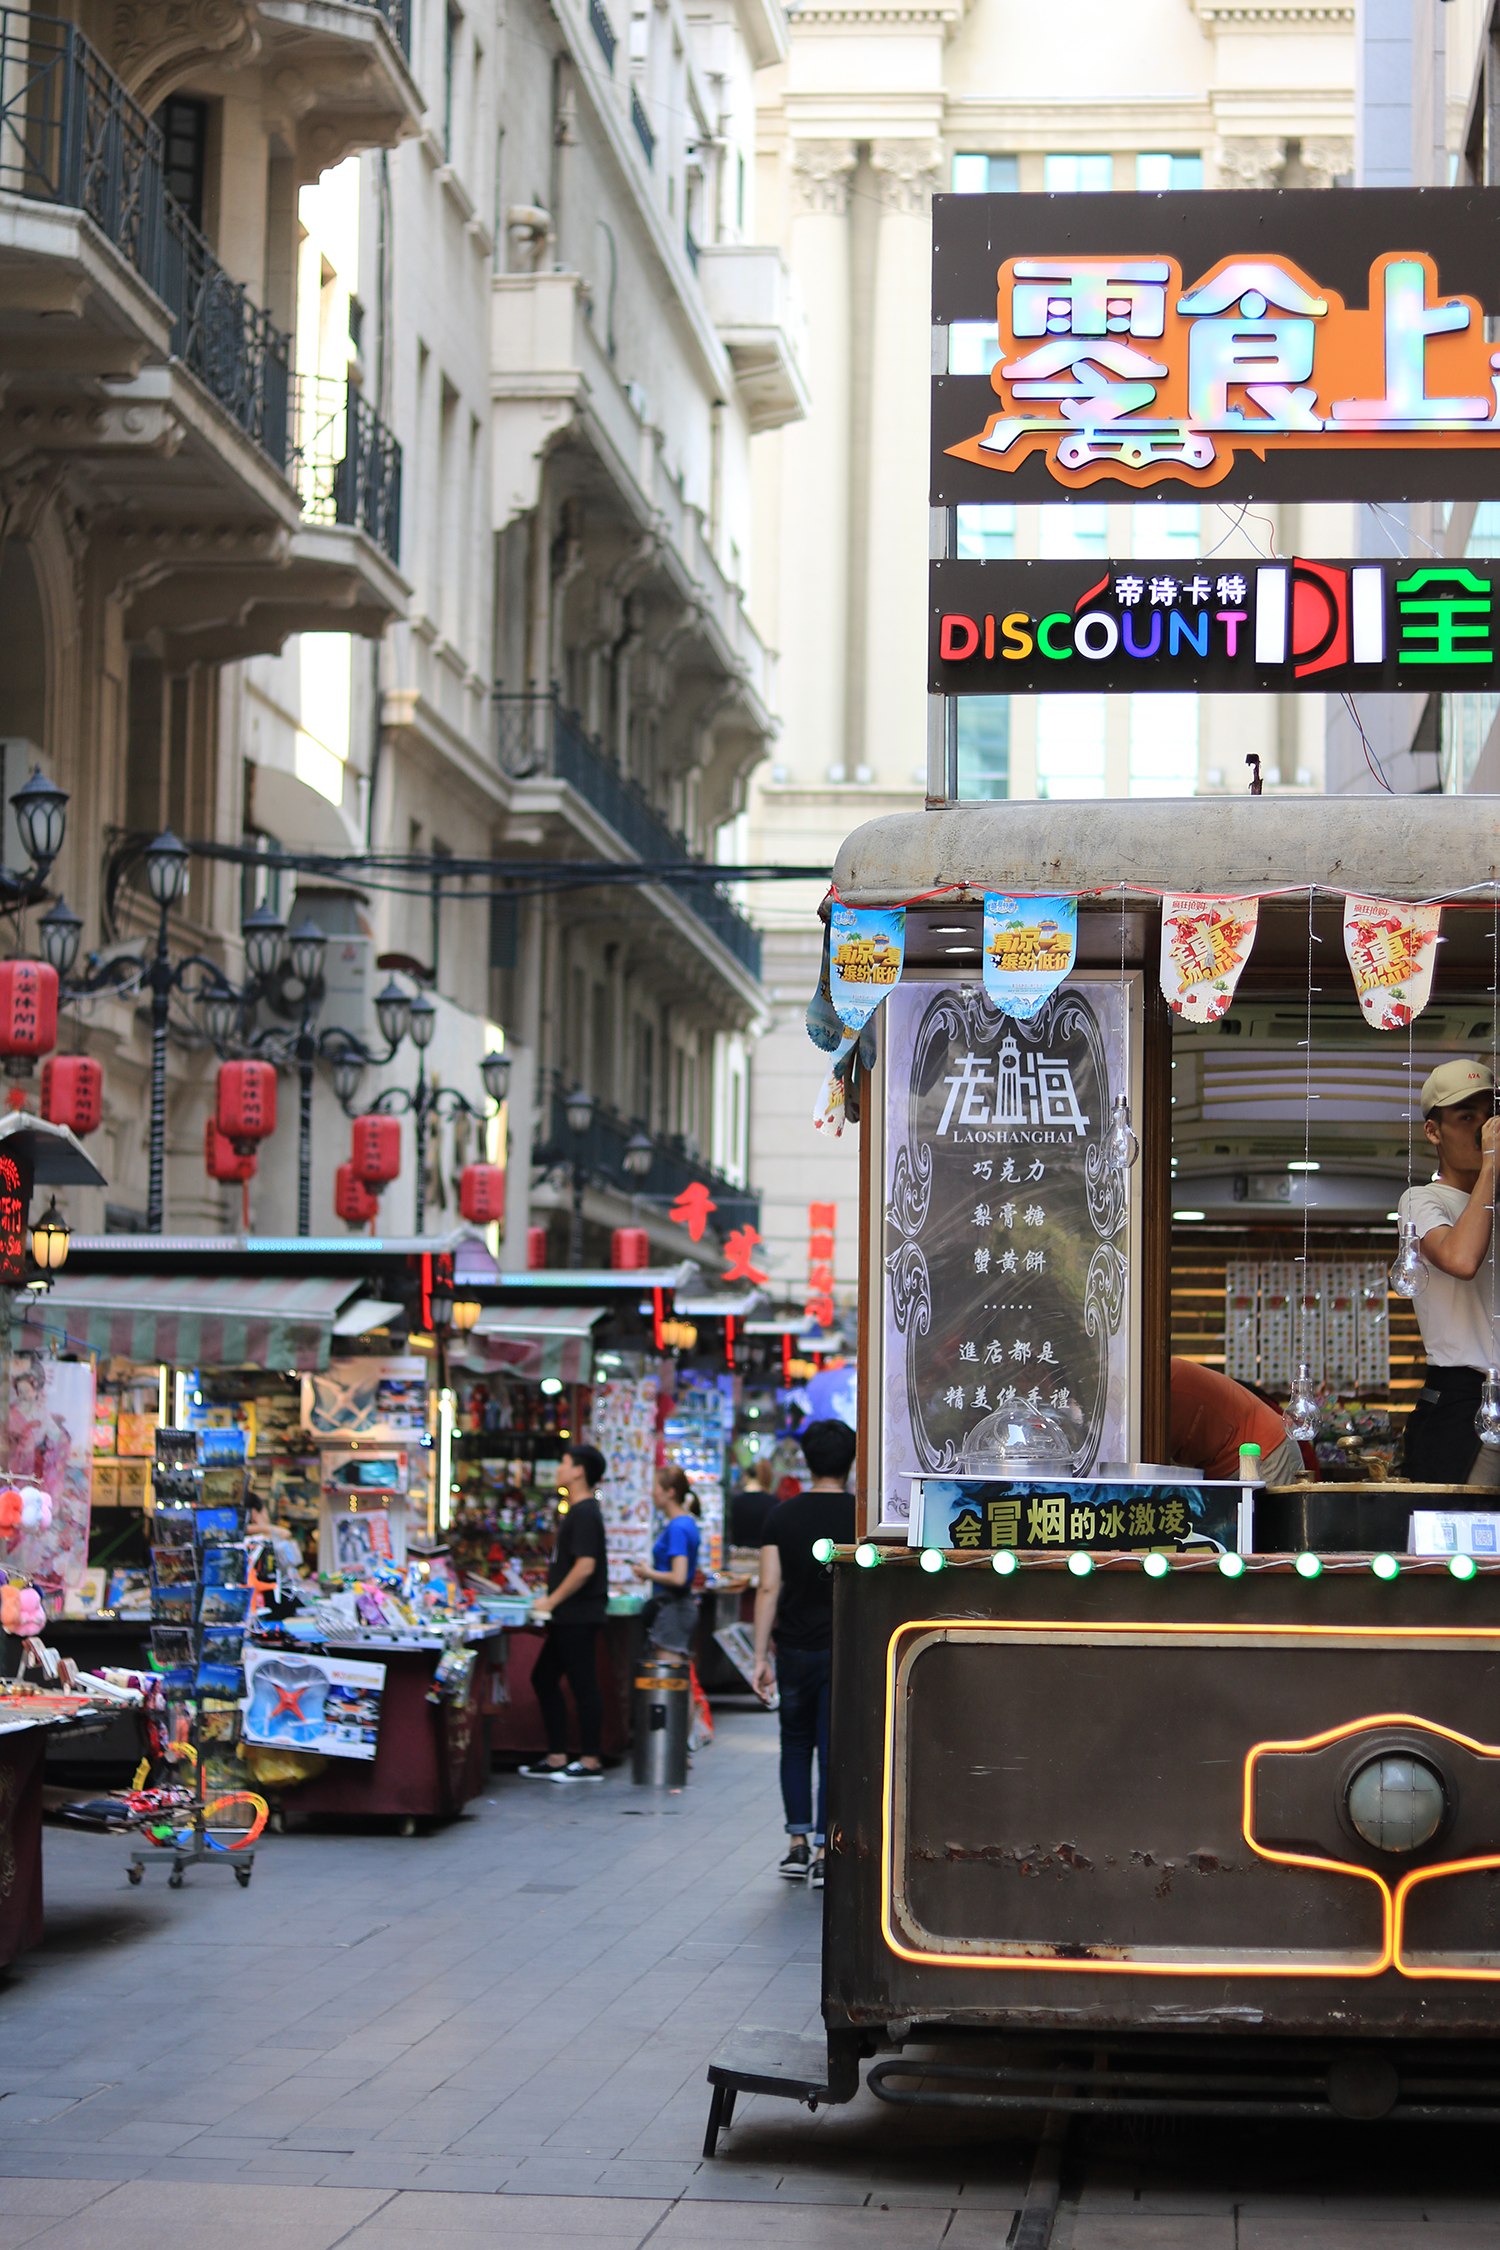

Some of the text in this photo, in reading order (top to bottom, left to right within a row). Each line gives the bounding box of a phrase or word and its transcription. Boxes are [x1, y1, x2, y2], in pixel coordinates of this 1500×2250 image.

[979, 262, 1500, 468] 零食上
[1115, 575, 1247, 606] 帝诗卡特
[940, 611, 1247, 660] DISCOUNT
[1171, 901, 1208, 911] 疯狂抢购
[1353, 904, 1389, 915] 疯狂抢购
[832, 939, 902, 967] 清凉一夏
[985, 927, 1073, 955] 清凉一夏
[841, 965, 898, 984] 缤纷低价
[998, 953, 1070, 971] 缤纷低价
[1203, 959, 1234, 982] SALE
[1379, 966, 1411, 988] SALE
[936, 1030, 1090, 1136] 老上海
[953, 1130, 1073, 1143] LAOSHANGHAI
[972, 1157, 1045, 1183] 巧克力
[971, 1202, 1046, 1229] 梨膏糖
[958, 1339, 1059, 1365] 進店都是
[955, 1498, 1185, 1547] 会冒烟的冰激凌
